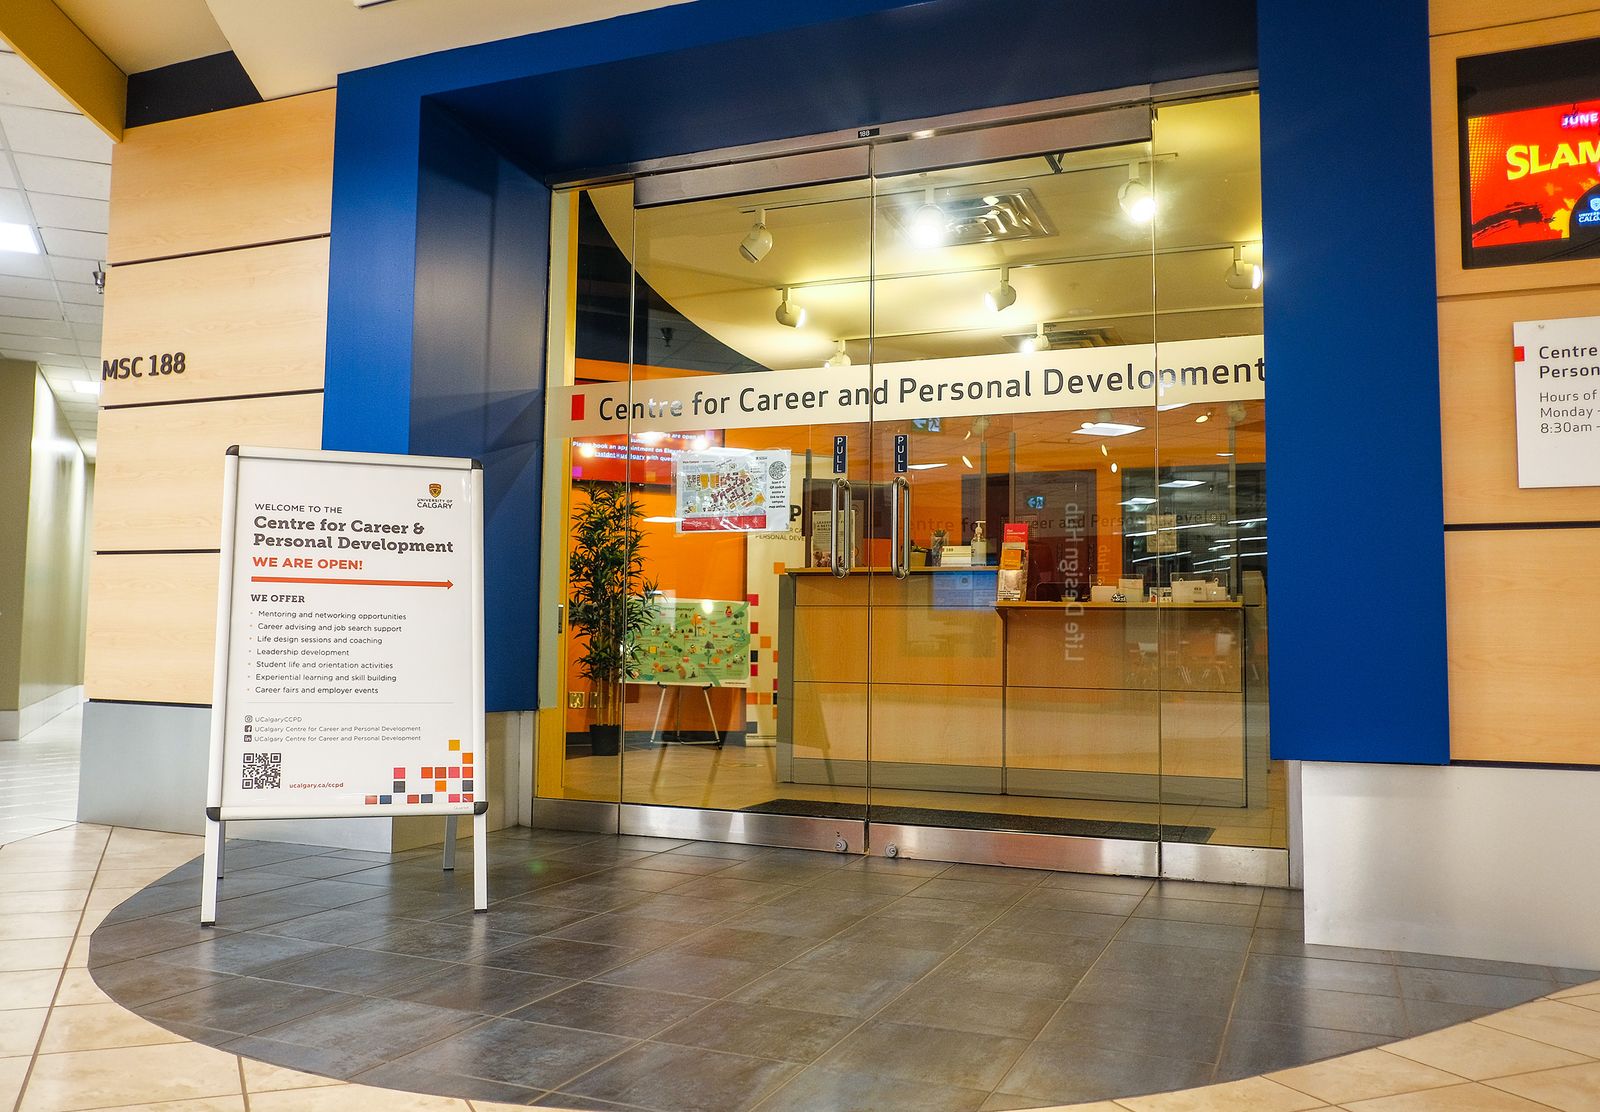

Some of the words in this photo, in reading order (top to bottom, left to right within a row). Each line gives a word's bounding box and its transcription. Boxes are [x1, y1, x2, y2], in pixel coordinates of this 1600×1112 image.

[1562, 112, 1598, 126] JUNE
[1539, 346, 1598, 359] Centre
[102, 357, 143, 380] MSC
[148, 352, 185, 376] 188
[599, 397, 683, 421] Centre
[692, 392, 730, 416] for
[740, 388, 829, 412] Career
[838, 380, 888, 406] and
[900, 370, 1031, 403] Personal
[1044, 357, 1265, 397] Development
[1540, 392, 1579, 402] Hours
[1583, 390, 1597, 401] of
[1540, 407, 1593, 418] Monday
[1540, 422, 1592, 433] 8:30am
[255, 503, 305, 512] WELCOME
[254, 516, 315, 530] Centre
[320, 519, 346, 532] for
[351, 520, 408, 534] Career
[413, 523, 424, 534] &
[253, 533, 332, 548] Personal
[338, 536, 454, 554] Development
[253, 557, 278, 567] WE
[282, 558, 313, 568] ARE
[318, 559, 363, 570] OPEN!
[270, 594, 305, 603] OFFER
